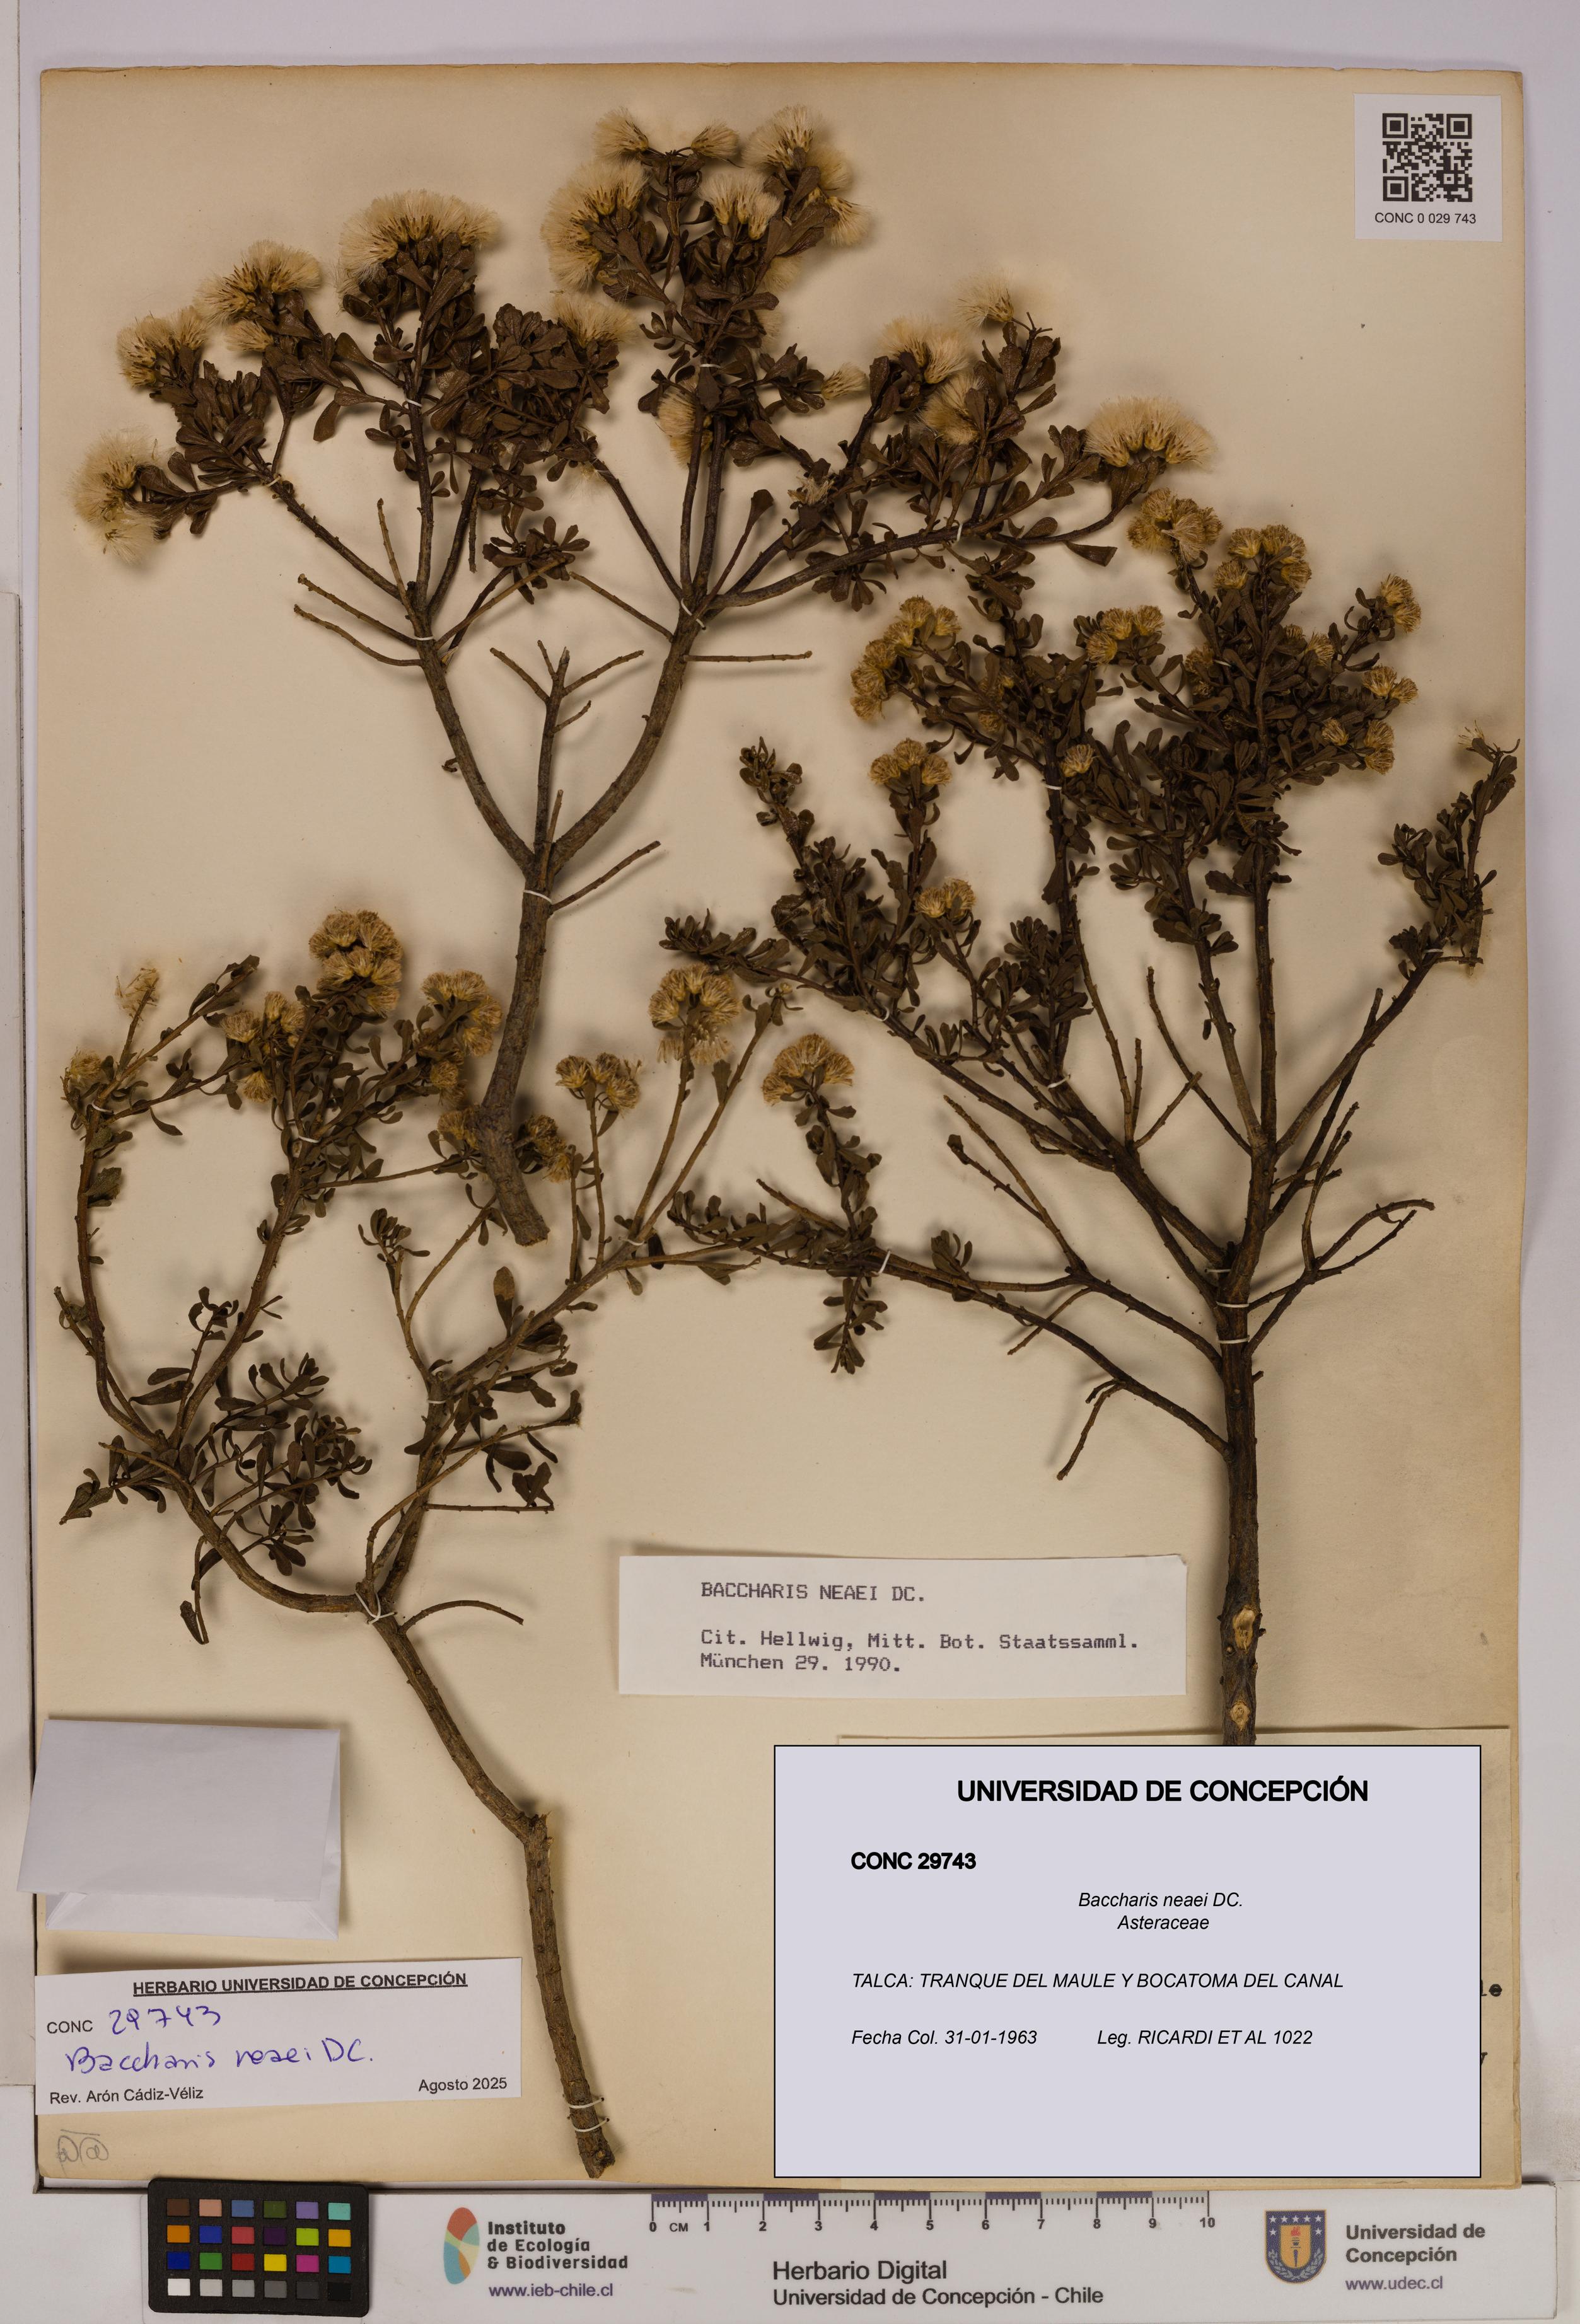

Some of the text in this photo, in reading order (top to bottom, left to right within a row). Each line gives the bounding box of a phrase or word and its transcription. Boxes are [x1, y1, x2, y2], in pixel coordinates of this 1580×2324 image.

[1374, 212, 1477, 224] CONC 0 029 743
[700, 1581, 924, 1602] BACCHARIS NEAEI DC.
[701, 1629, 1137, 1651] Cit. Hellwig, Mitt. Bot. Staatssamml.
[700, 1652, 900, 1672] München 29. 1990.
[132, 1970, 468, 1996] HERBARIO UNIVERSIDAD DE CONCEPCIÓN
[47, 2005, 221, 2035] CONC 29743
[65, 2042, 216, 2074] Baccharis
[321, 2037, 373, 2062] DC.
[50, 2086, 204, 2105] Rev. Arón Cádiz-Véliz
[418, 2077, 508, 2095] Agosto 2025
[488, 2220, 566, 2235] Instituto
[649, 2217, 1216, 2233] 0 CM 1 2 3 4 5 6 7 8 9 10
[1346, 2223, 1485, 2240] Universidad de
[487, 2238, 590, 2255] de Ecología
[1345, 2246, 1457, 2266] Concepción
[487, 2253, 628, 2270] & Biodiversidad
[773, 2260, 947, 2285] Herbario Digital
[489, 2283, 613, 2297] www.ieb-chile.cl
[1345, 2275, 1443, 2291] www.udec.cl
[774, 2288, 886, 2306] Universidad
[892, 2288, 916, 2305] de
[922, 2287, 1035, 2308] Concepción
[1055, 2287, 1104, 2304] Chile
